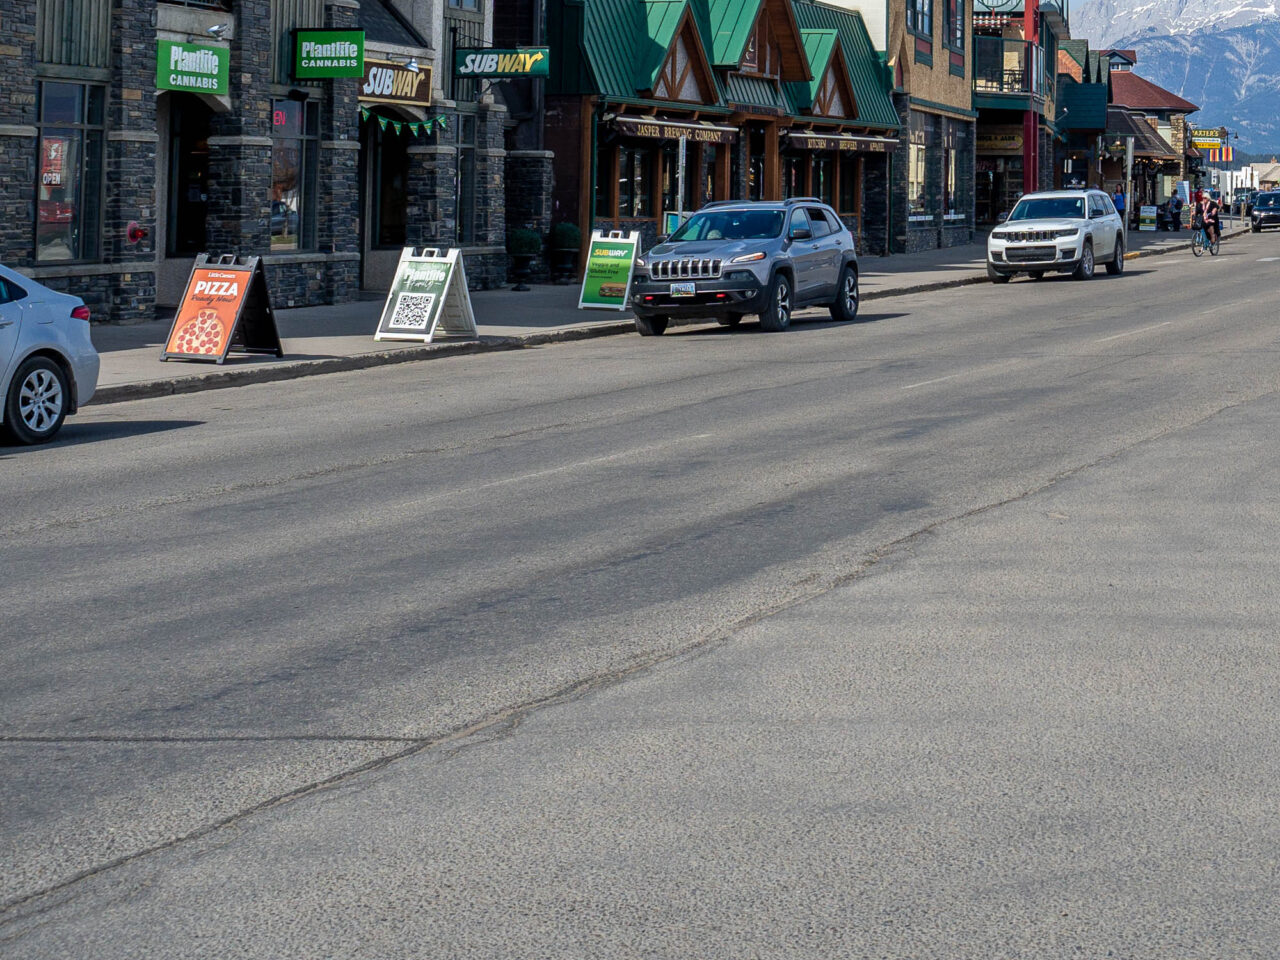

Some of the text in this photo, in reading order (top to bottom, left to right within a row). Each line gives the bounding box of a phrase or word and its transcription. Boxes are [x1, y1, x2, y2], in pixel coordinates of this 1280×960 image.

[302, 41, 358, 58] Plantlife
[170, 45, 219, 75] Plantlife
[302, 59, 358, 67] CANNABIS
[460, 51, 544, 74] SUBWAY
[169, 74, 218, 89] CANNABIS
[363, 66, 425, 98] SUBWAY
[637, 124, 722, 142] JASPER BREWING COMPANY
[43, 173, 60, 184] OPEN
[403, 268, 446, 282] Plantlife
[193, 280, 239, 296] PIZZA
